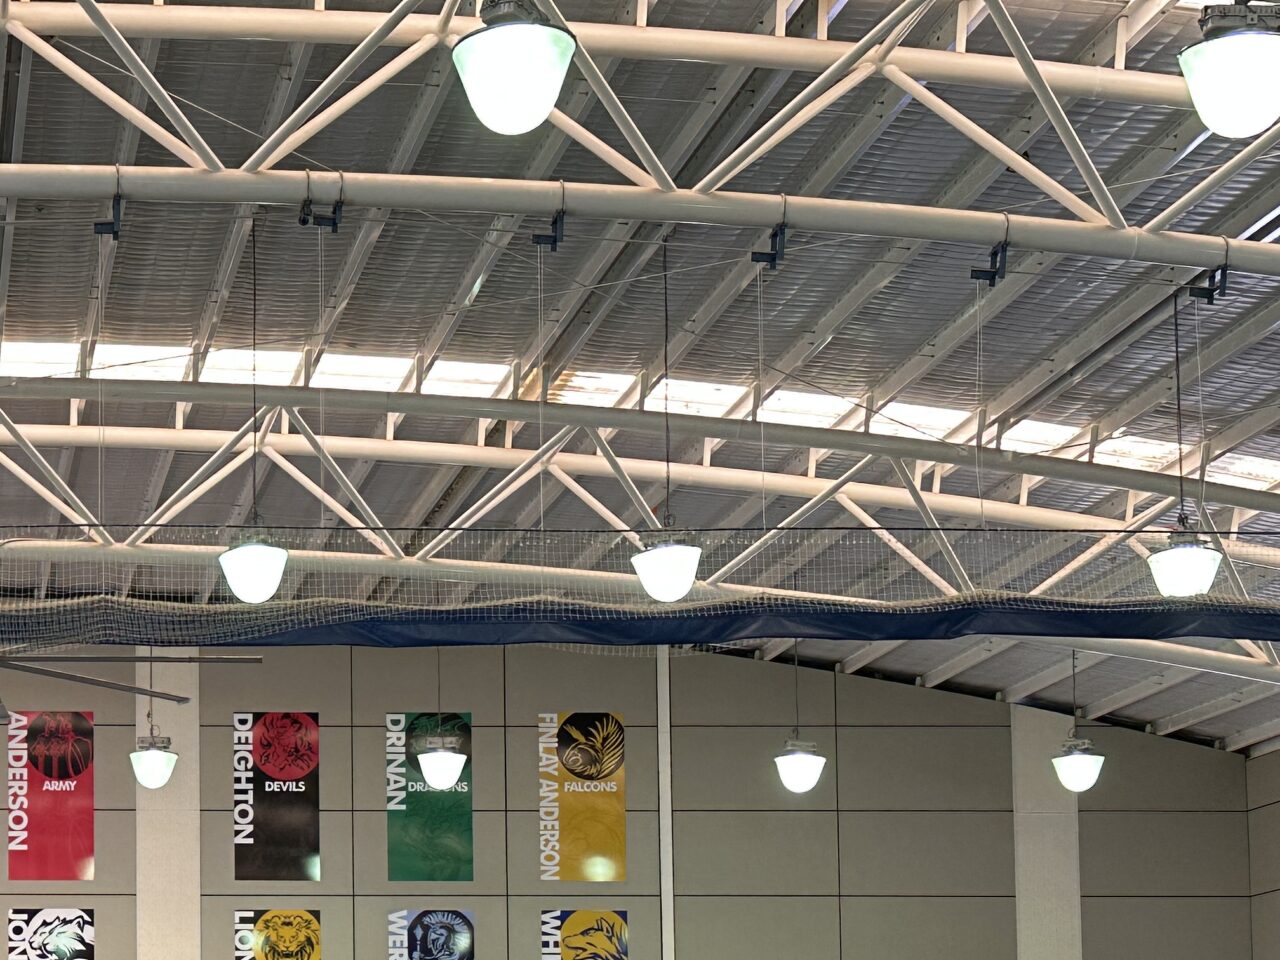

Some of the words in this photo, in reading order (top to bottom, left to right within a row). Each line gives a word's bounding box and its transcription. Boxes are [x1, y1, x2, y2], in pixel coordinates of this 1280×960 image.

[8, 712, 28, 851] ANDERSON
[233, 713, 254, 844] DEIGHTON
[386, 713, 407, 810] DRINAN
[538, 713, 558, 775] FINLAY
[42, 780, 77, 791] ARMY
[265, 781, 305, 792] DEVILS
[564, 782, 617, 792] FALCONS
[539, 779, 560, 881] ANDERSON
